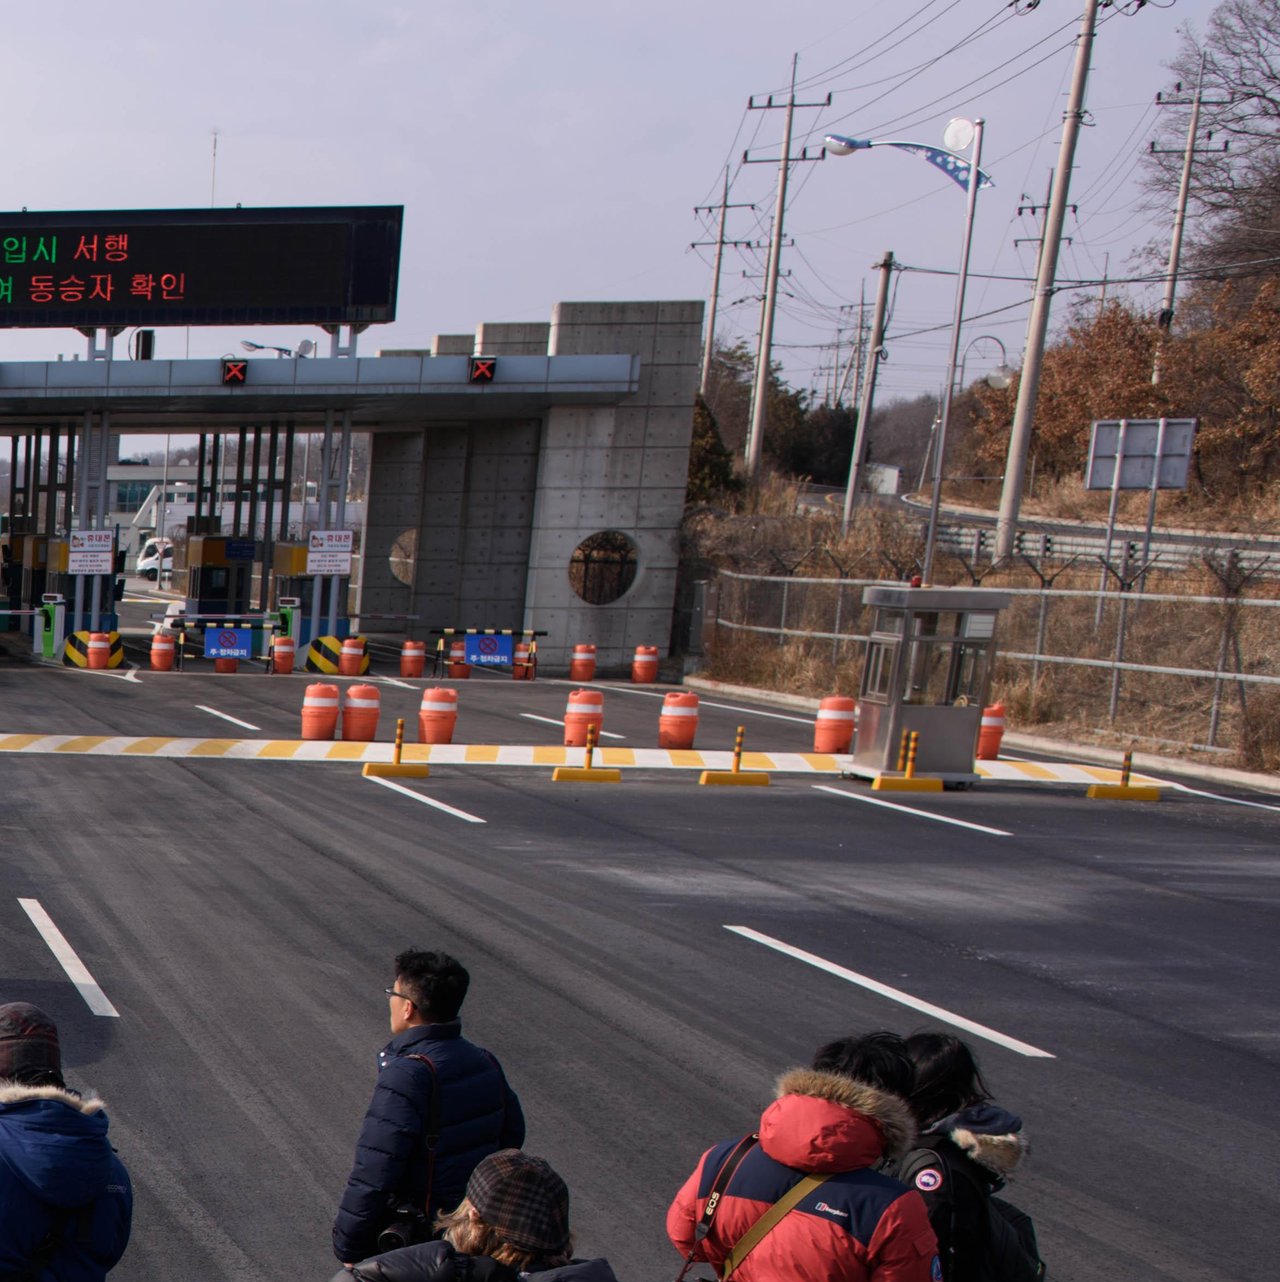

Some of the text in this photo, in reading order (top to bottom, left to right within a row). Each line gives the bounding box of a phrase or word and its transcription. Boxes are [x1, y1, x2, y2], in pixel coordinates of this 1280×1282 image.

[74, 232, 130, 263] 서행
[28, 273, 115, 303] 동승자
[129, 272, 187, 302] 확인
[706, 1191, 720, 1216] EOS
